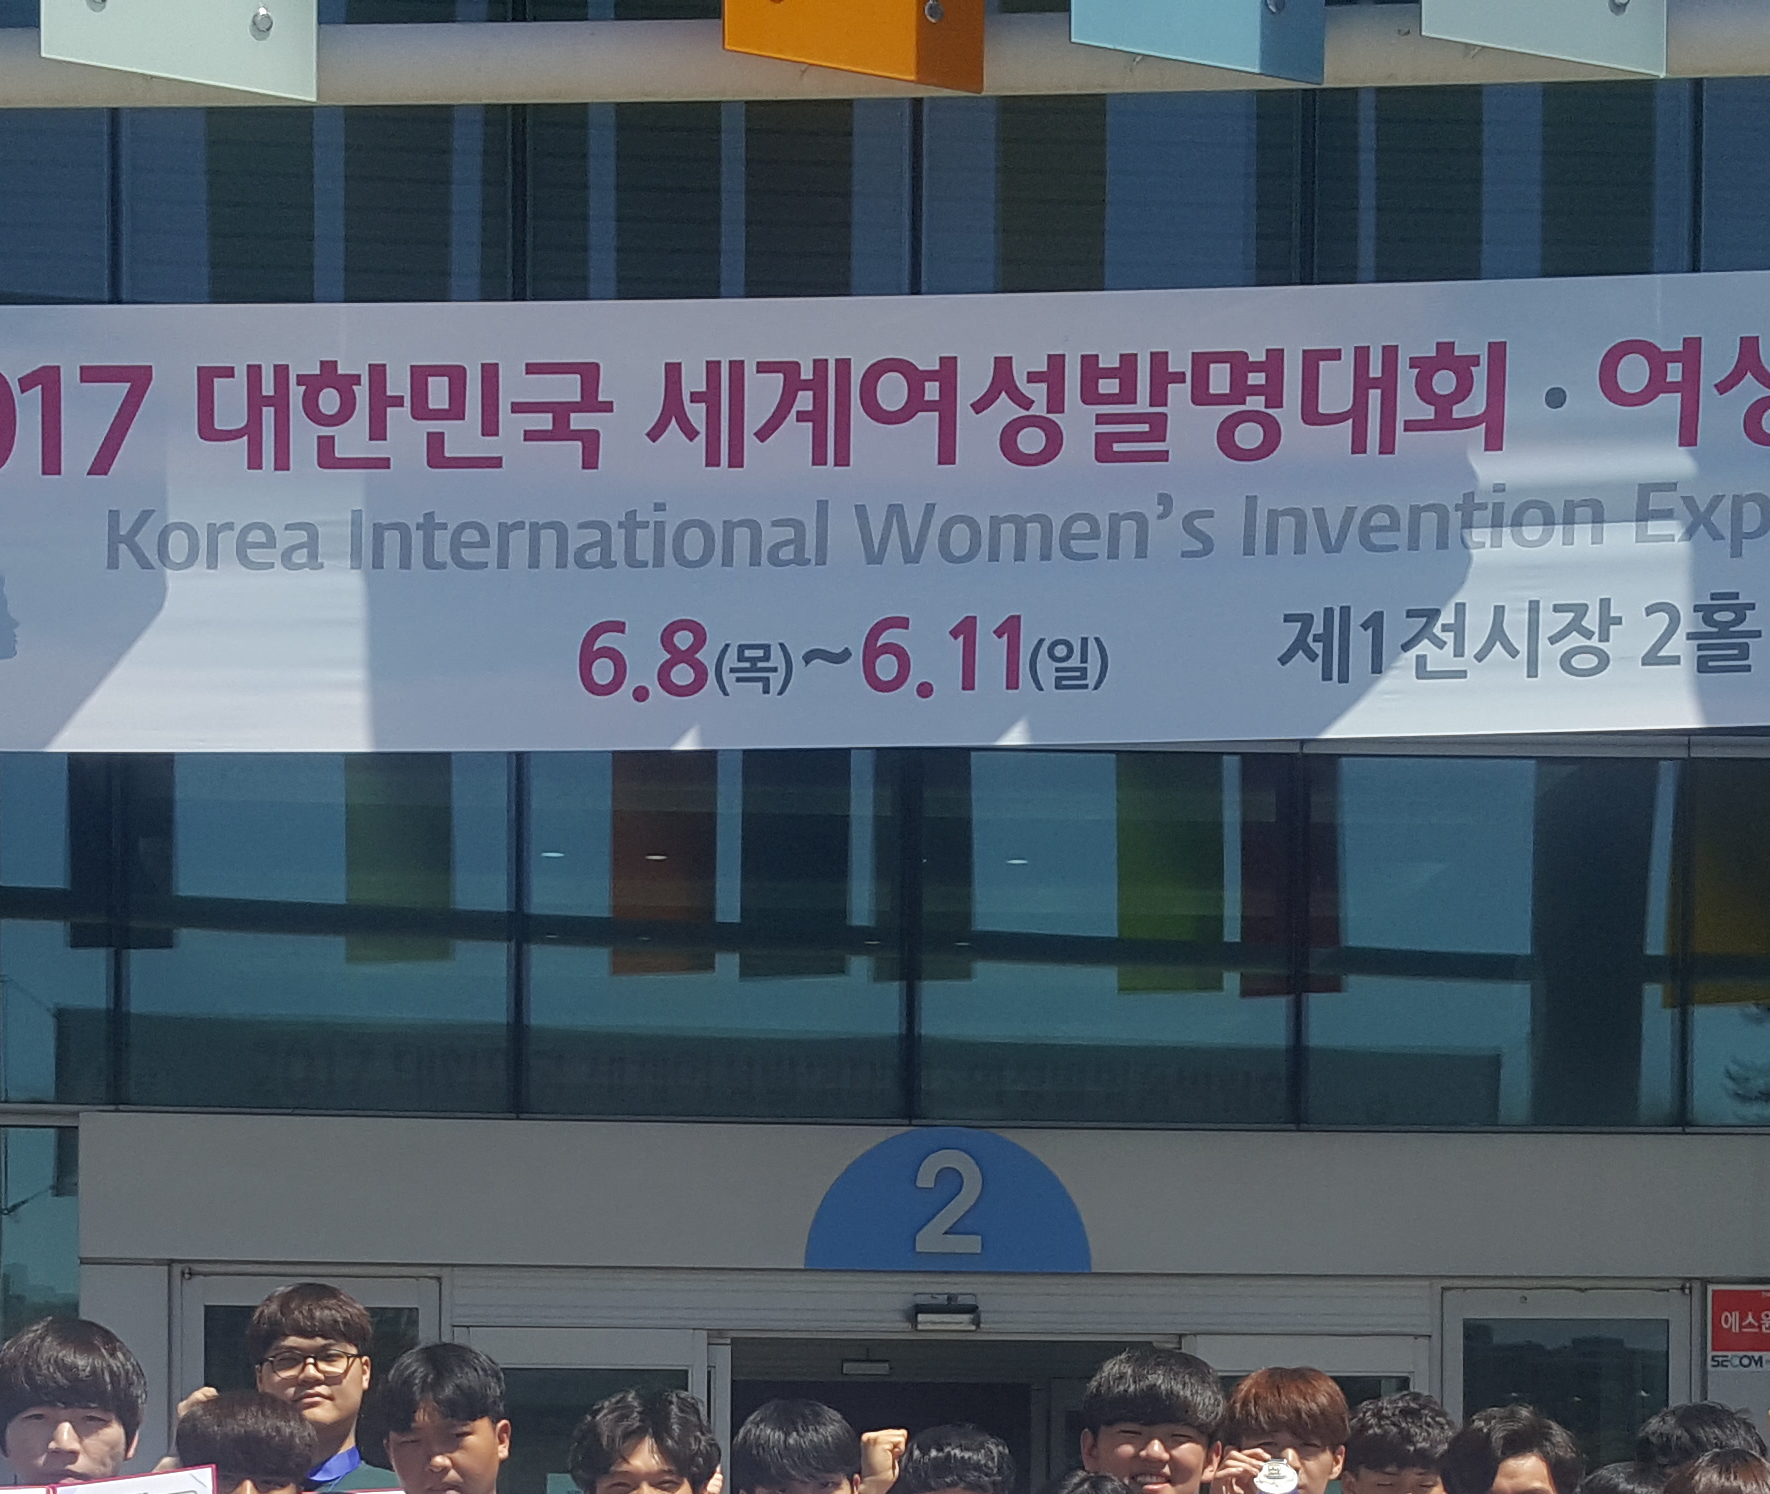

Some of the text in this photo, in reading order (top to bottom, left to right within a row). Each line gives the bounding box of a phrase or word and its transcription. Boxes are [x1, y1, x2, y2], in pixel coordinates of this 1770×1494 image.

[195, 360, 614, 472] 대한민국
[645, 340, 1508, 470] 세계여성발명대회
[106, 508, 324, 571] Korea
[350, 500, 829, 571] International
[1242, 482, 1604, 558] Invention
[1276, 597, 1623, 683] 제1전시장
[1640, 590, 1763, 676] 2홀
[915, 1148, 983, 1254] 2
[1711, 1354, 1763, 1368] SECOM
